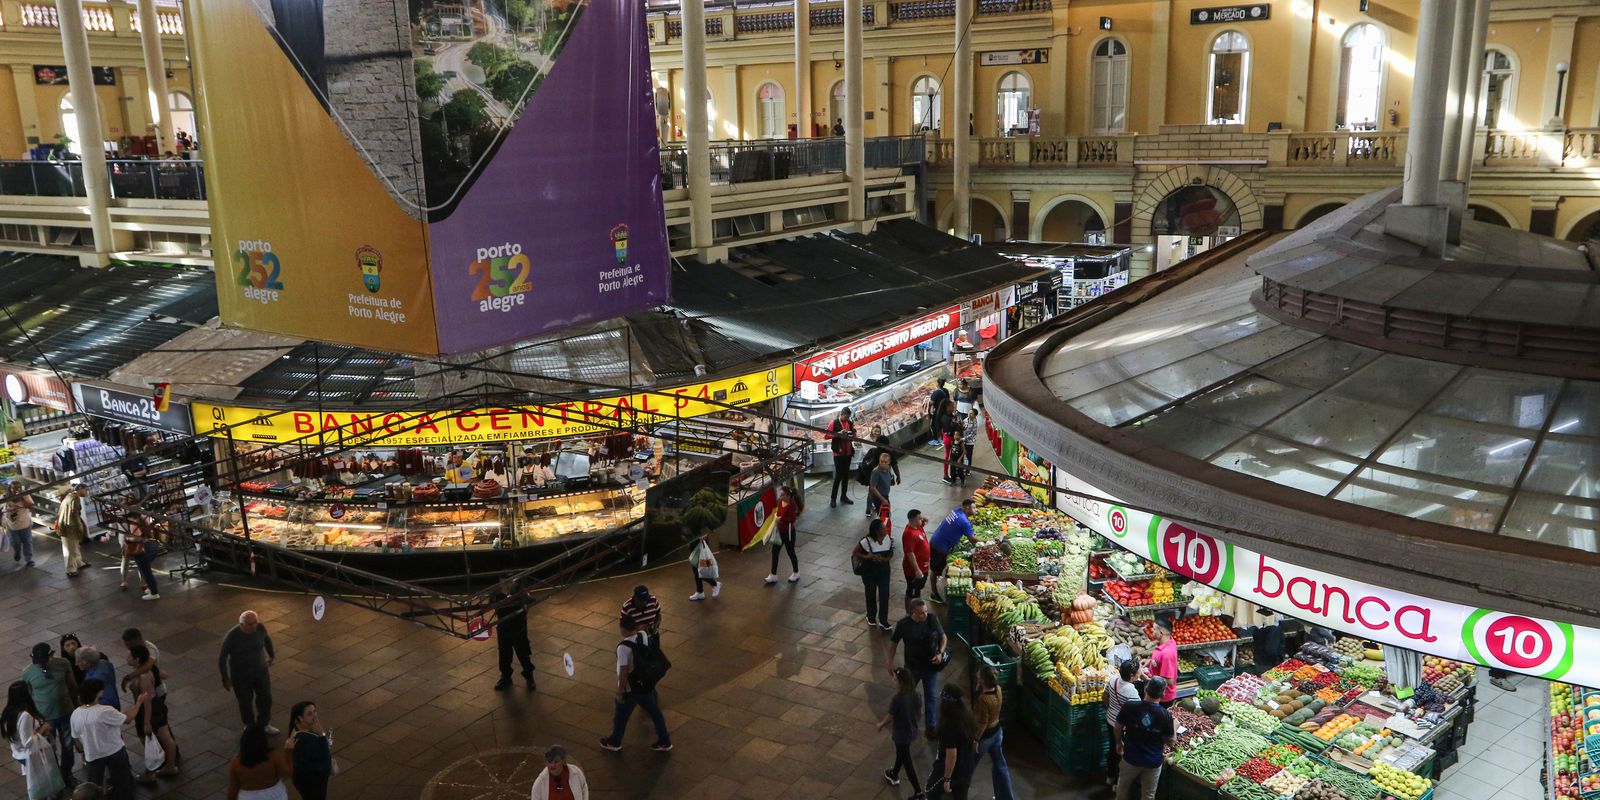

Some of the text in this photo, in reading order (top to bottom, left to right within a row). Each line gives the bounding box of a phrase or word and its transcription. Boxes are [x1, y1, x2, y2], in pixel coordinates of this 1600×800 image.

[1213, 9, 1246, 21] MERCADO
[238, 239, 272, 253] porto
[476, 242, 522, 263] porto
[233, 251, 285, 290] 252
[468, 253, 533, 301] 252
[599, 266, 633, 281] Prefeitura
[244, 286, 279, 304] alegre
[512, 283, 530, 293] anos
[598, 280, 621, 293] Porto
[348, 293, 402, 309] Prefeitura de
[479, 293, 525, 312] alegre
[348, 305, 406, 324] Porto Alegre
[812, 359, 836, 377] CASA
[838, 351, 851, 367] DE
[850, 340, 883, 362] CARNES
[883, 331, 910, 350] SANTO
[766, 369, 777, 383] QI
[765, 384, 779, 398] FG
[100, 390, 140, 416] BANCA
[139, 398, 161, 421] 25
[212, 407, 226, 421] QI
[293, 384, 711, 436] BANCA CENTRAL 54
[382, 437, 403, 445] 1957
[405, 433, 484, 444] ESPECIALIZADA
[486, 432, 501, 440] EM
[503, 428, 553, 439] FIAMBRES
[564, 422, 617, 434] PRODUOS
[1064, 478, 1101, 518] banca
[1112, 514, 1124, 530] 10
[1169, 532, 1212, 575] 10
[1253, 553, 1545, 660] banca 10
